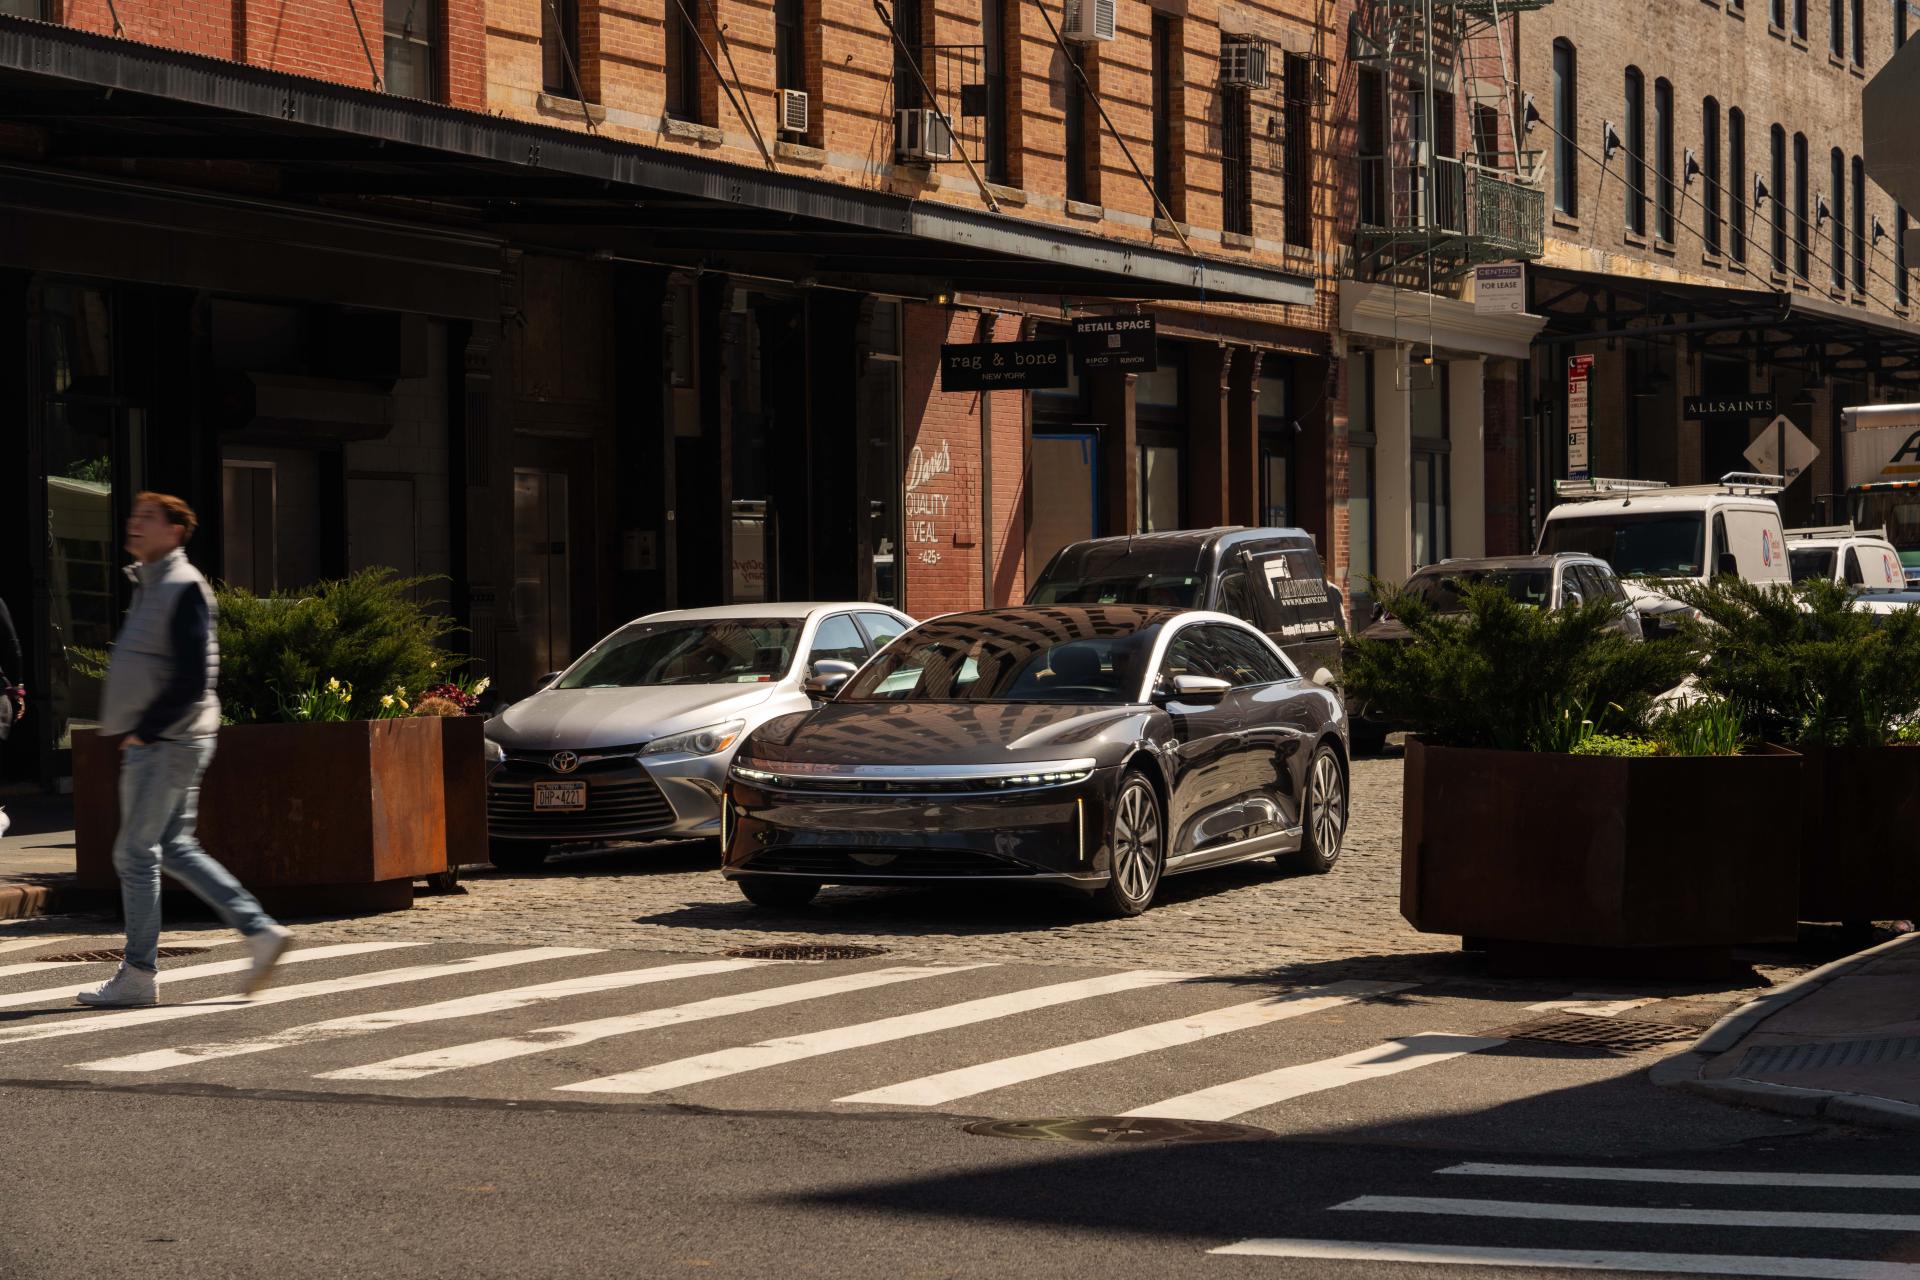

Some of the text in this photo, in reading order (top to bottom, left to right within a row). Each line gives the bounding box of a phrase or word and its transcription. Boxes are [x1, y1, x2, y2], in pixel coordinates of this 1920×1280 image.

[1497, 281, 1518, 289] LEASE
[1077, 320, 1151, 333] RETAIL SPACE
[951, 352, 1057, 369] rag & bone
[1688, 400, 1773, 413] ALLSAINTS
[906, 439, 950, 491] Dave's
[905, 492, 949, 518] QUALITY
[912, 521, 939, 543] VEAL
